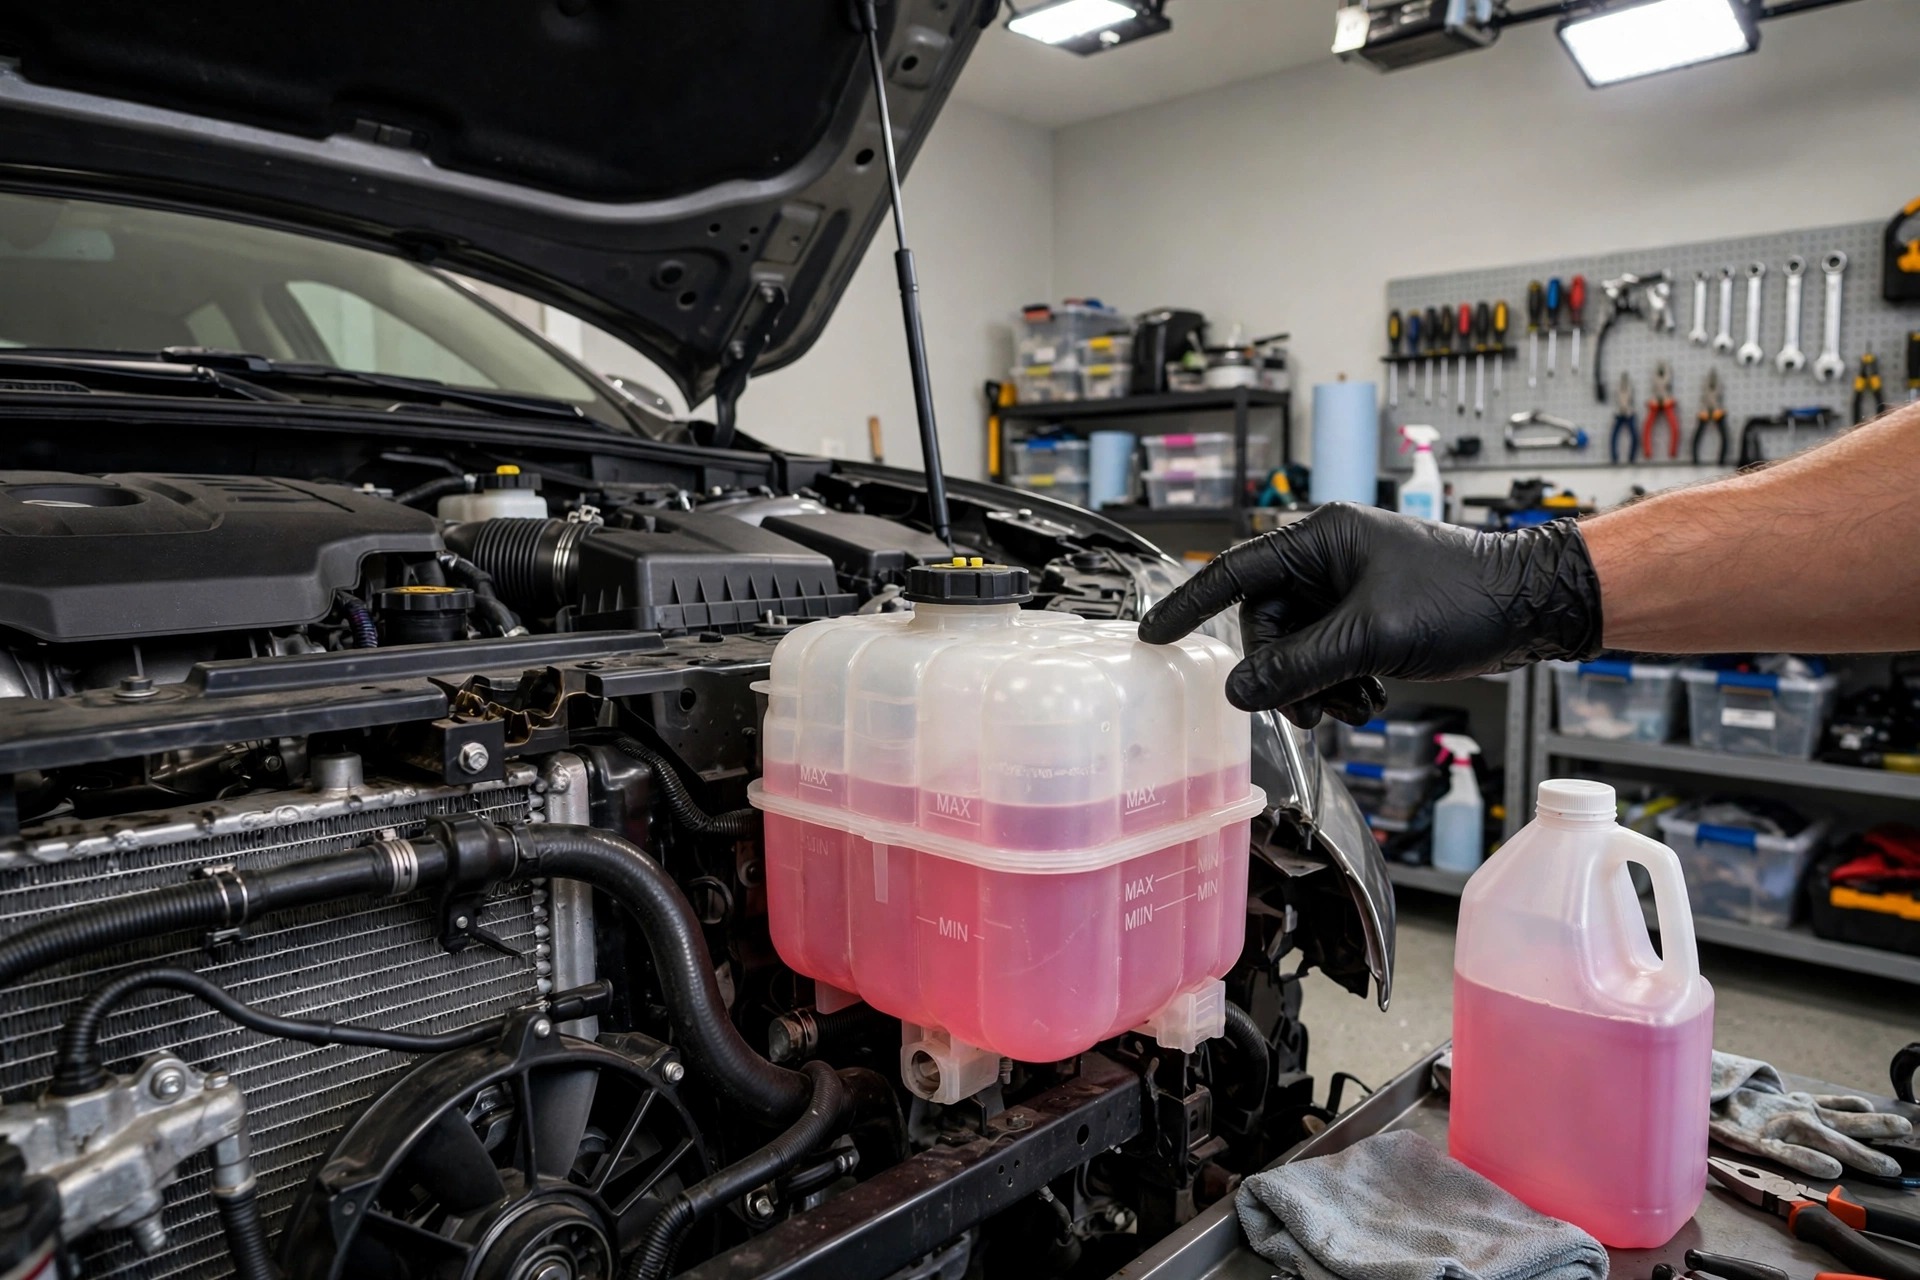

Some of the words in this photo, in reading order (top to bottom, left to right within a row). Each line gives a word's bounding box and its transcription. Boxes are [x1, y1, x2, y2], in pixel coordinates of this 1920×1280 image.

[800, 765, 828, 787] MAX
[936, 793, 971, 818] MAX
[1126, 782, 1156, 809] MAX
[1125, 874, 1154, 902] MAX
[1125, 904, 1153, 931] MIIN
[1197, 878, 1219, 902] MIN
[939, 916, 968, 942] MIN
